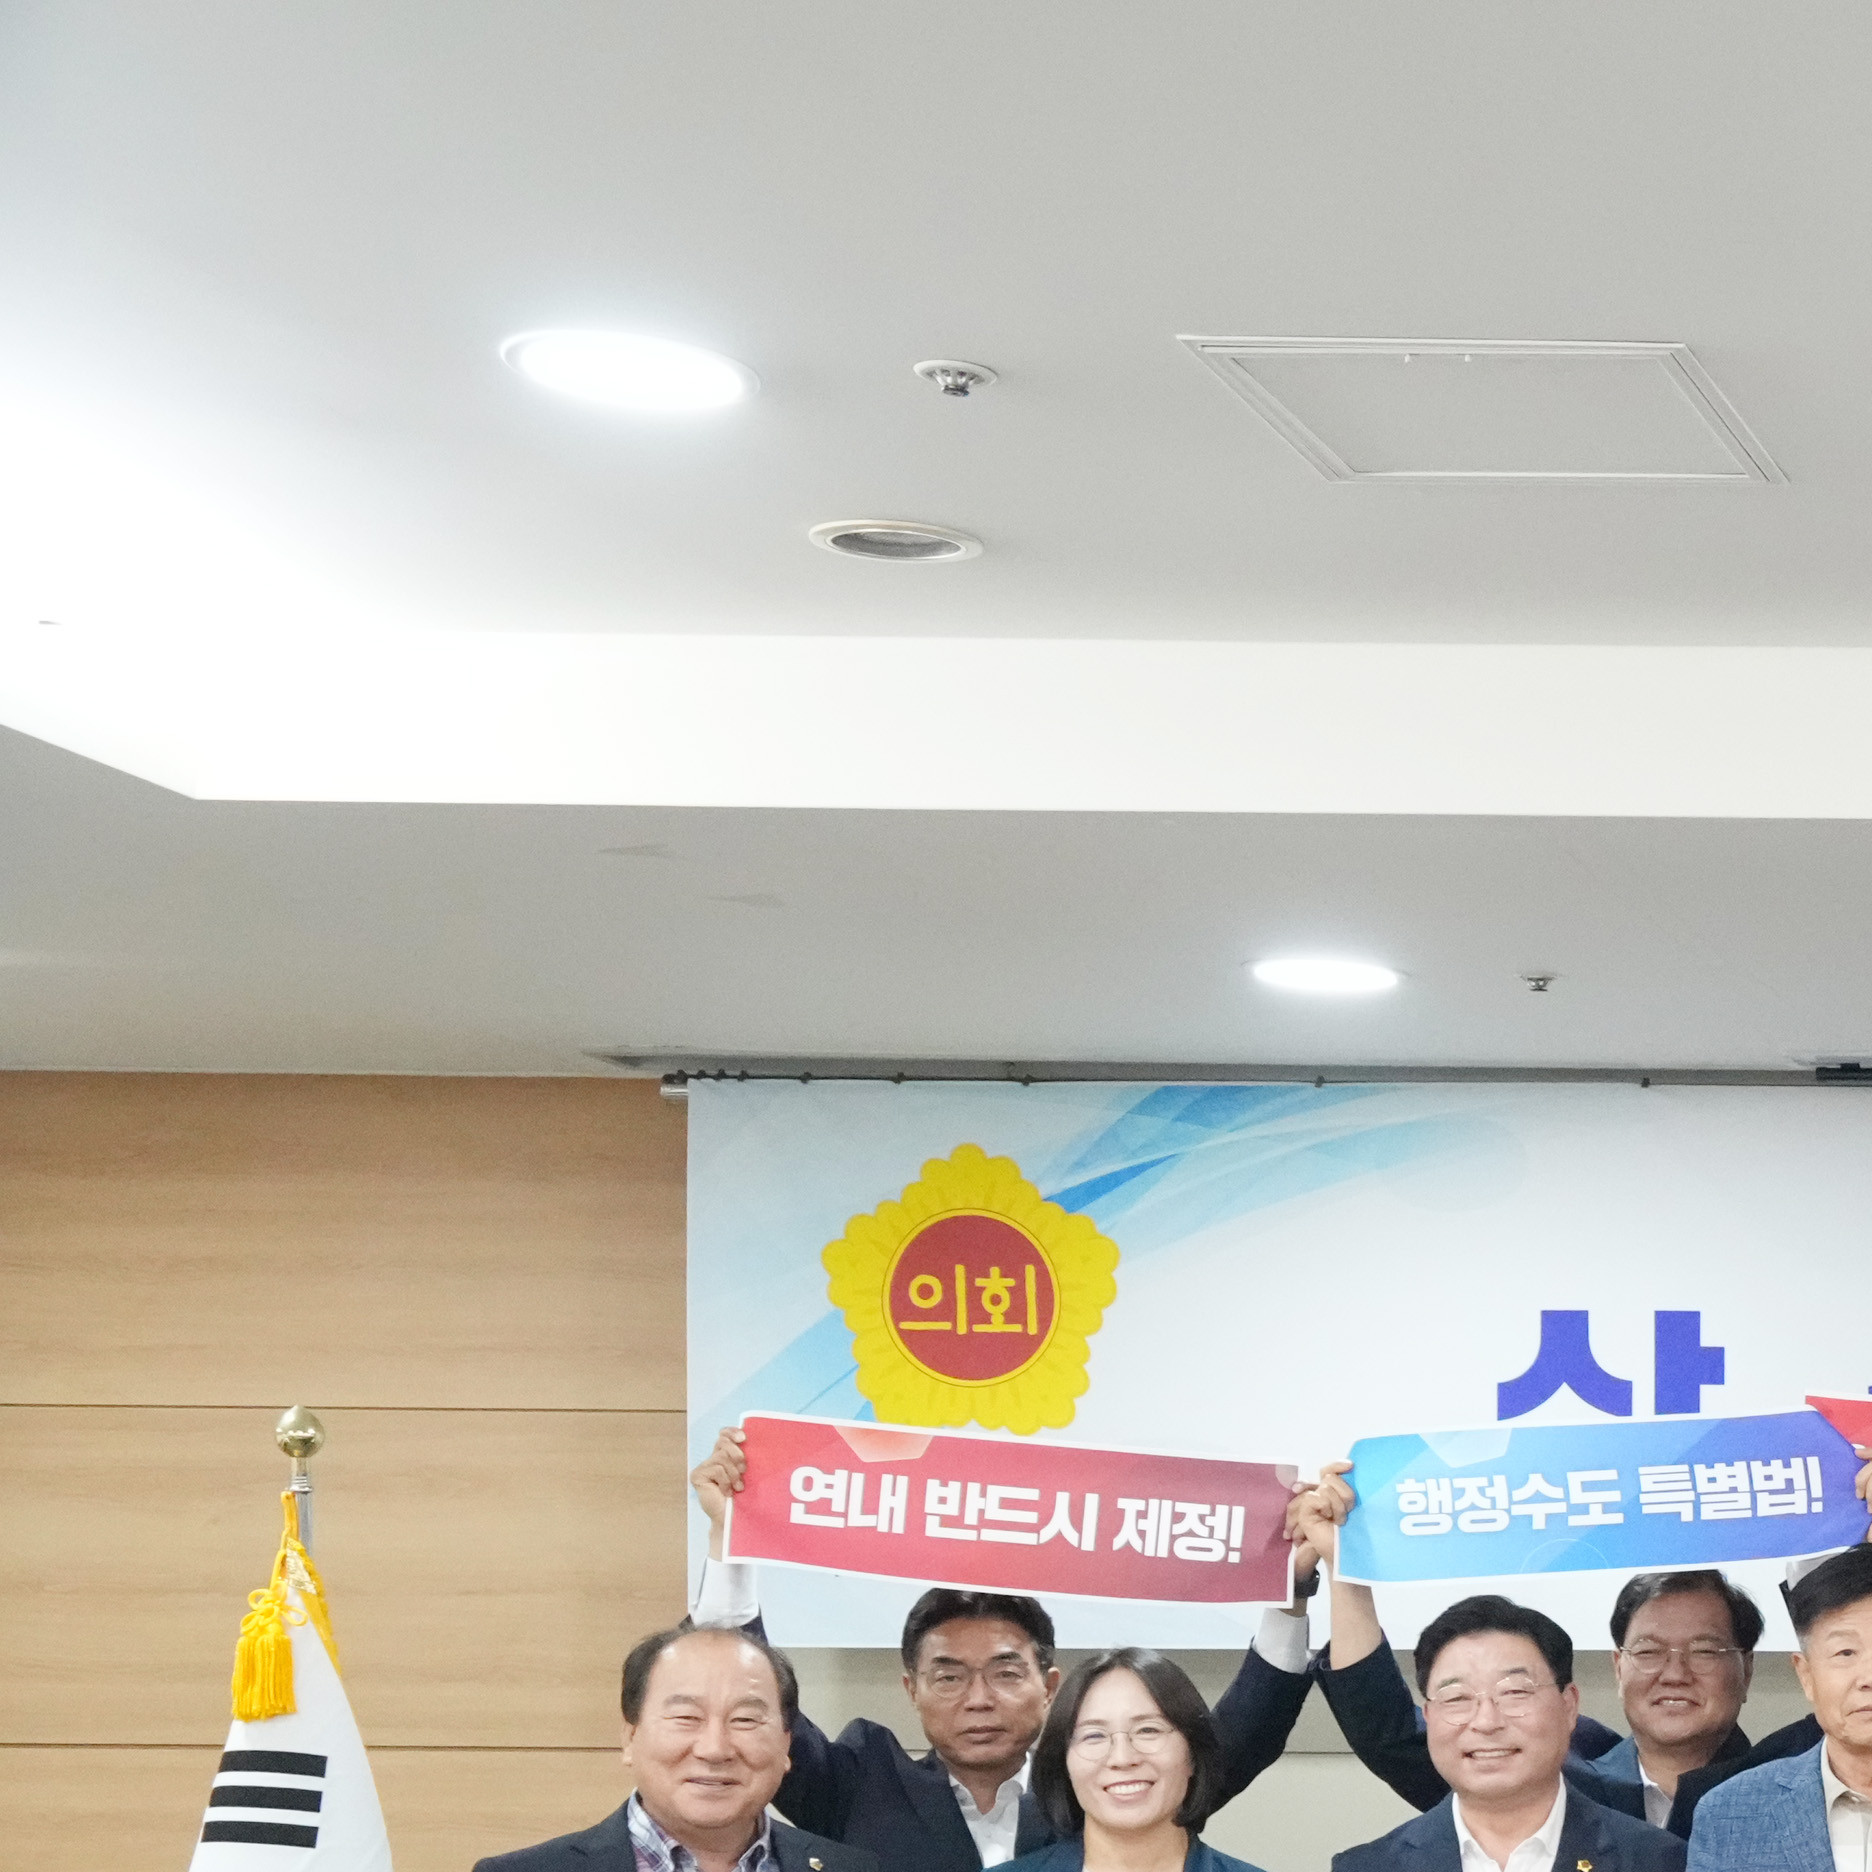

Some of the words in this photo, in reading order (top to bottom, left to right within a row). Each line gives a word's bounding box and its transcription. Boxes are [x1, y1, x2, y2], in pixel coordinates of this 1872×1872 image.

[899, 1264, 1037, 1335] 의회
[790, 1466, 908, 1534] 연내
[925, 1479, 1099, 1551] 반드시
[1113, 1498, 1245, 1563] 제정!
[1396, 1470, 1623, 1535] 행정수도
[1638, 1457, 1822, 1521] 특별법!
